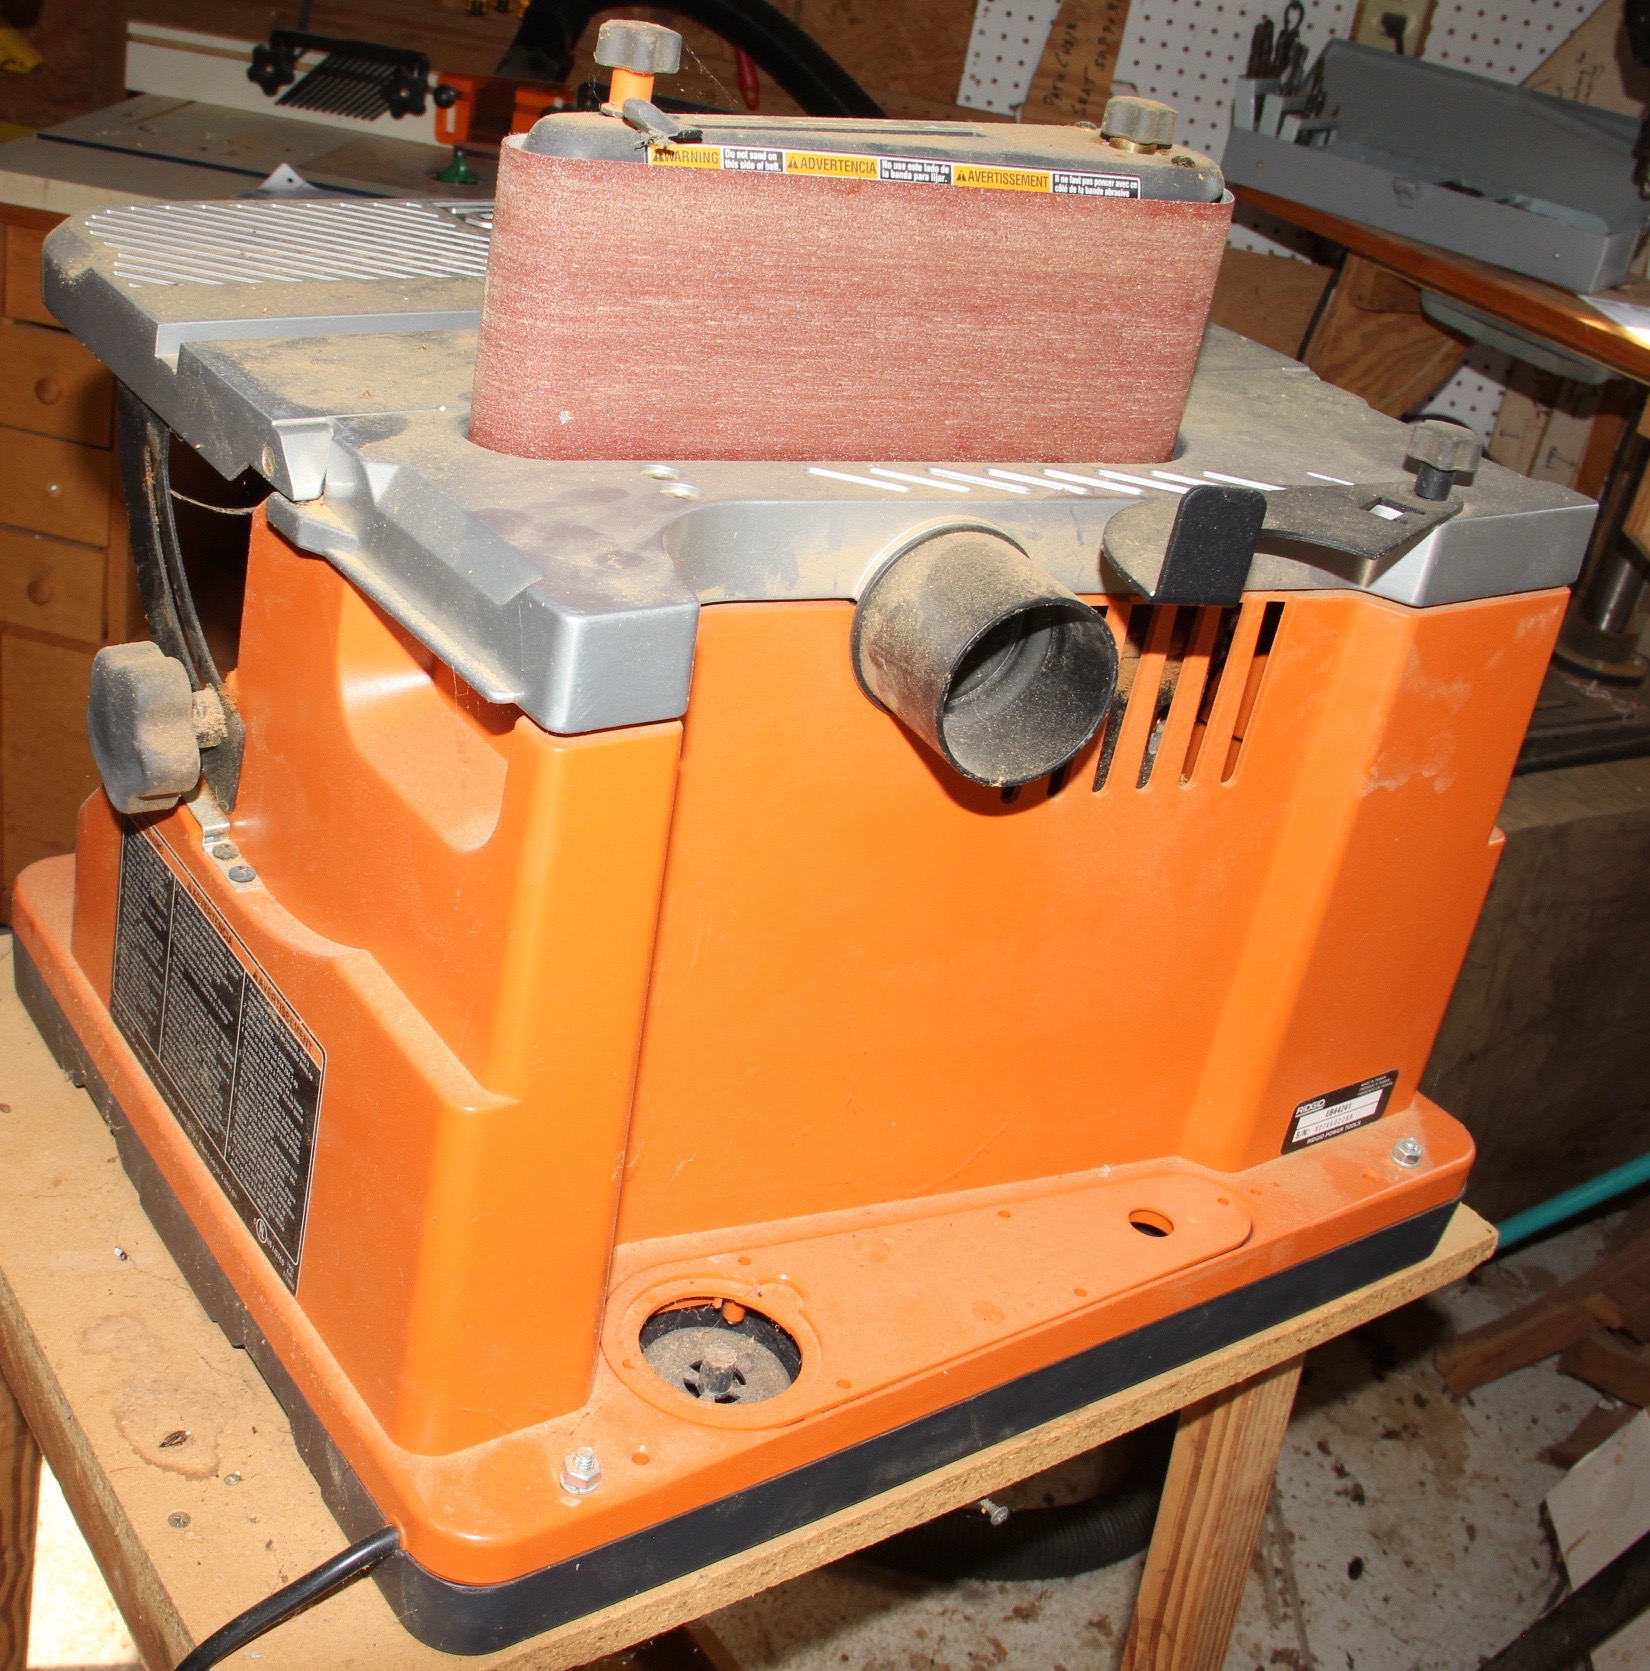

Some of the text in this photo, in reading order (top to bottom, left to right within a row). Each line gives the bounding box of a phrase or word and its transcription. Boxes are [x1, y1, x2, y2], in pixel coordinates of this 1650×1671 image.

[725, 149, 777, 161] Do not sand on
[725, 160, 781, 171] this side of belt.
[800, 157, 877, 174] ADVERTENCIA
[882, 160, 950, 174] No use este lado de
[882, 169, 948, 184] la banda para lijar.
[968, 170, 1049, 188] AVERTISSEMENT
[1054, 174, 1138, 189] Il ne faut pas poncer avec ce
[1054, 184, 1130, 198] côté de la bande abrasive
[192, 888, 232, 947] ADVERTENCIA
[258, 978, 313, 1052] AVERTISSEMENT
[1296, 1099, 1325, 1115] RIDGID
[1325, 1103, 1352, 1118] EB44241
[1295, 1127, 1310, 1139] S/N:
[1307, 1120, 1362, 1144] RIDGID POWER TOOLS
